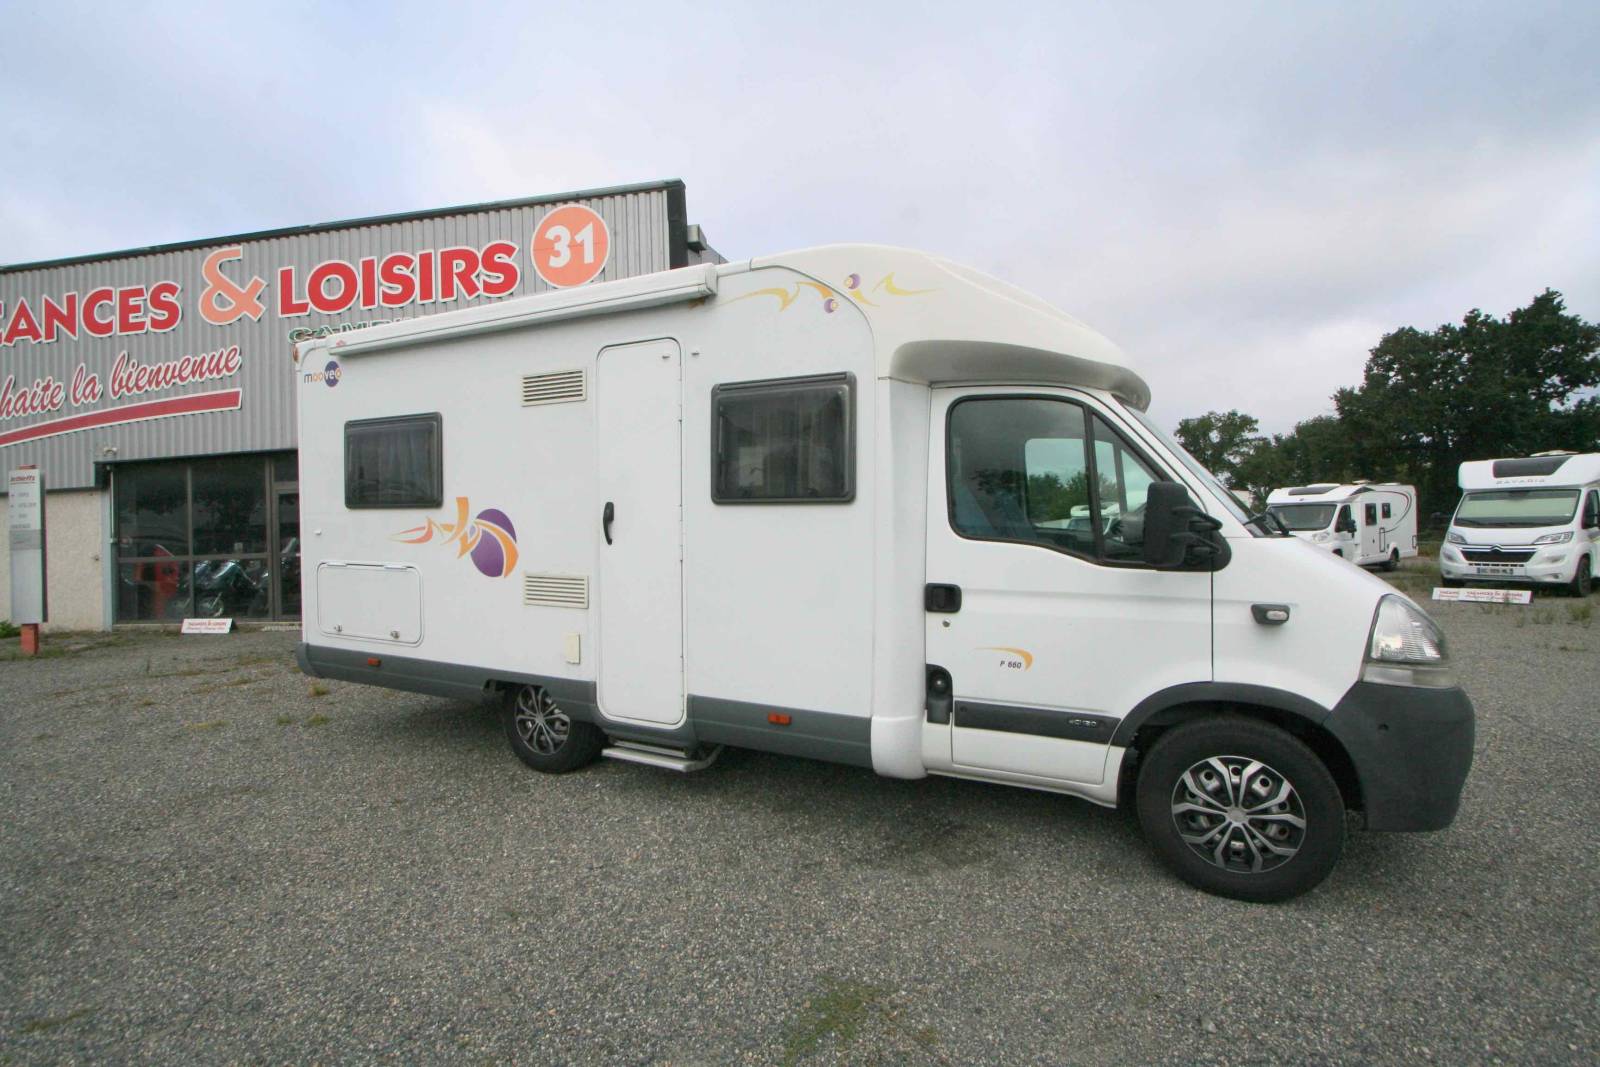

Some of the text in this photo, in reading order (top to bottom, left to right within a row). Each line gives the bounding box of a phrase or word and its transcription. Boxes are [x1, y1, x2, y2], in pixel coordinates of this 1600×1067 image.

[0, 220, 596, 345] ANCES & LOISIRS 31
[71, 362, 103, 406] la
[109, 350, 243, 400] bienvenue
[303, 367, 342, 385] mooveo
[1007, 660, 1022, 670] 660
